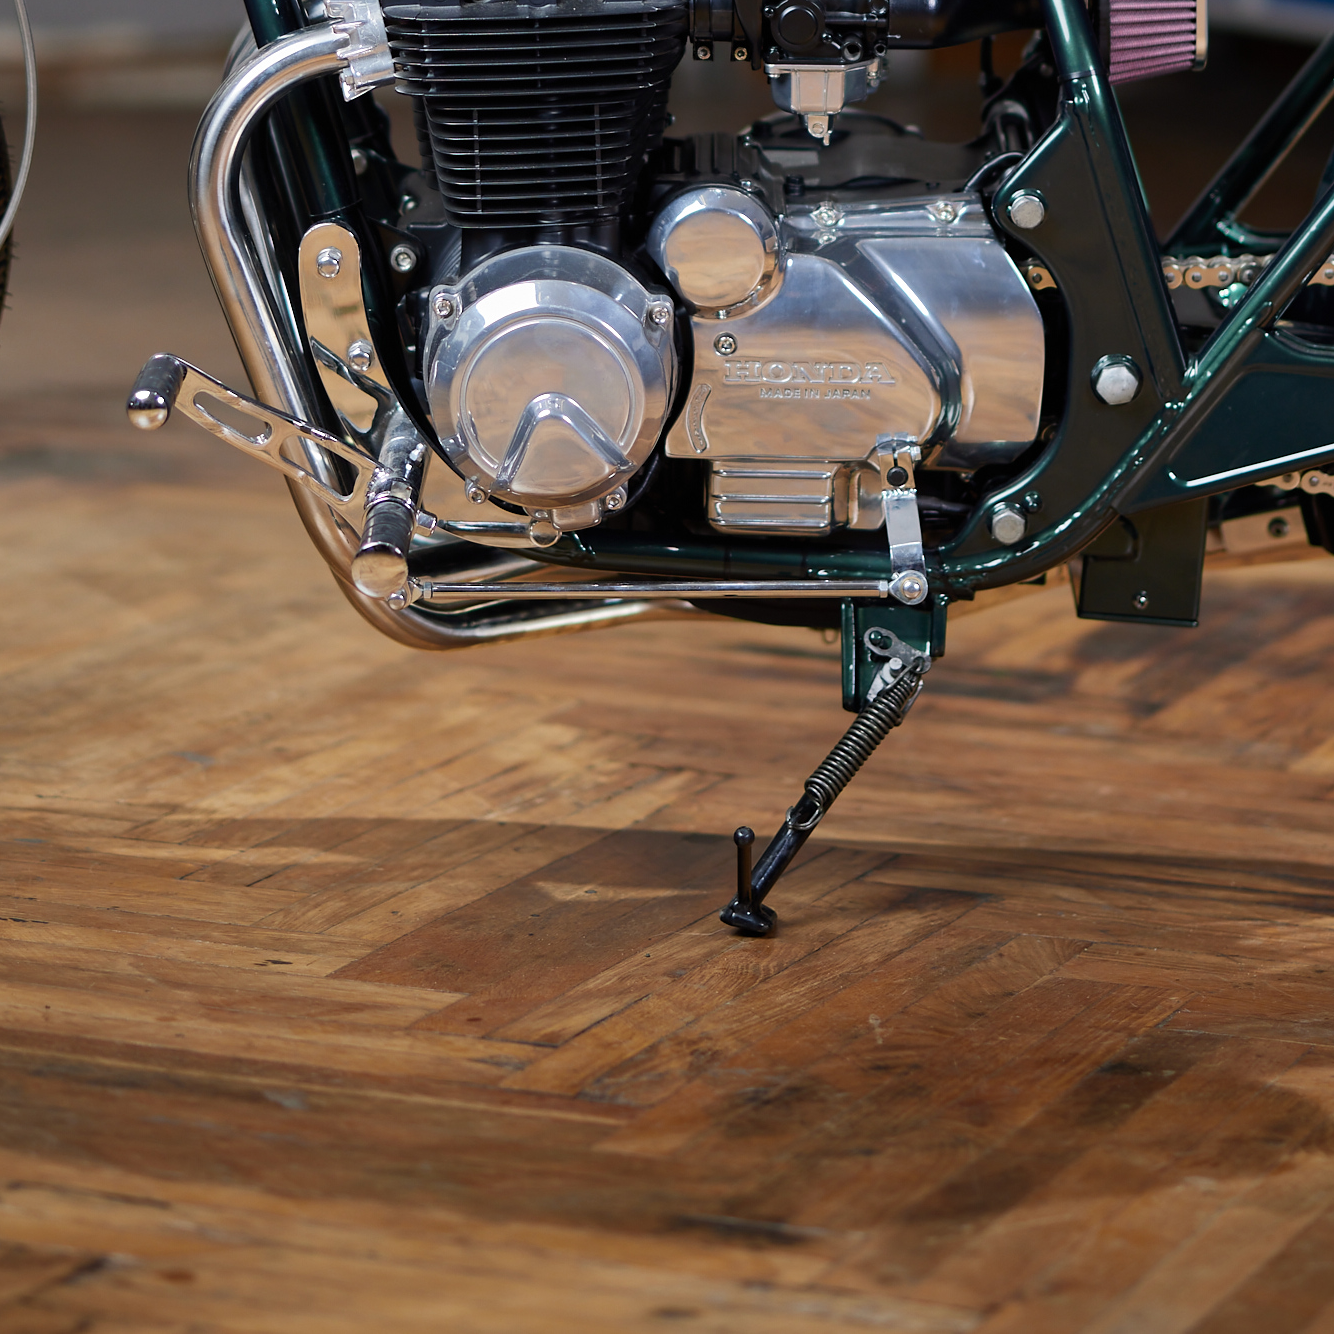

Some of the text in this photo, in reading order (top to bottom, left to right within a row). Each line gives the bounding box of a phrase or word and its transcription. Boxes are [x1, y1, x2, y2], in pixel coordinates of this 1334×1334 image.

[724, 360, 896, 384] HONDA
[760, 388, 871, 400] MADE IN JAPAN
